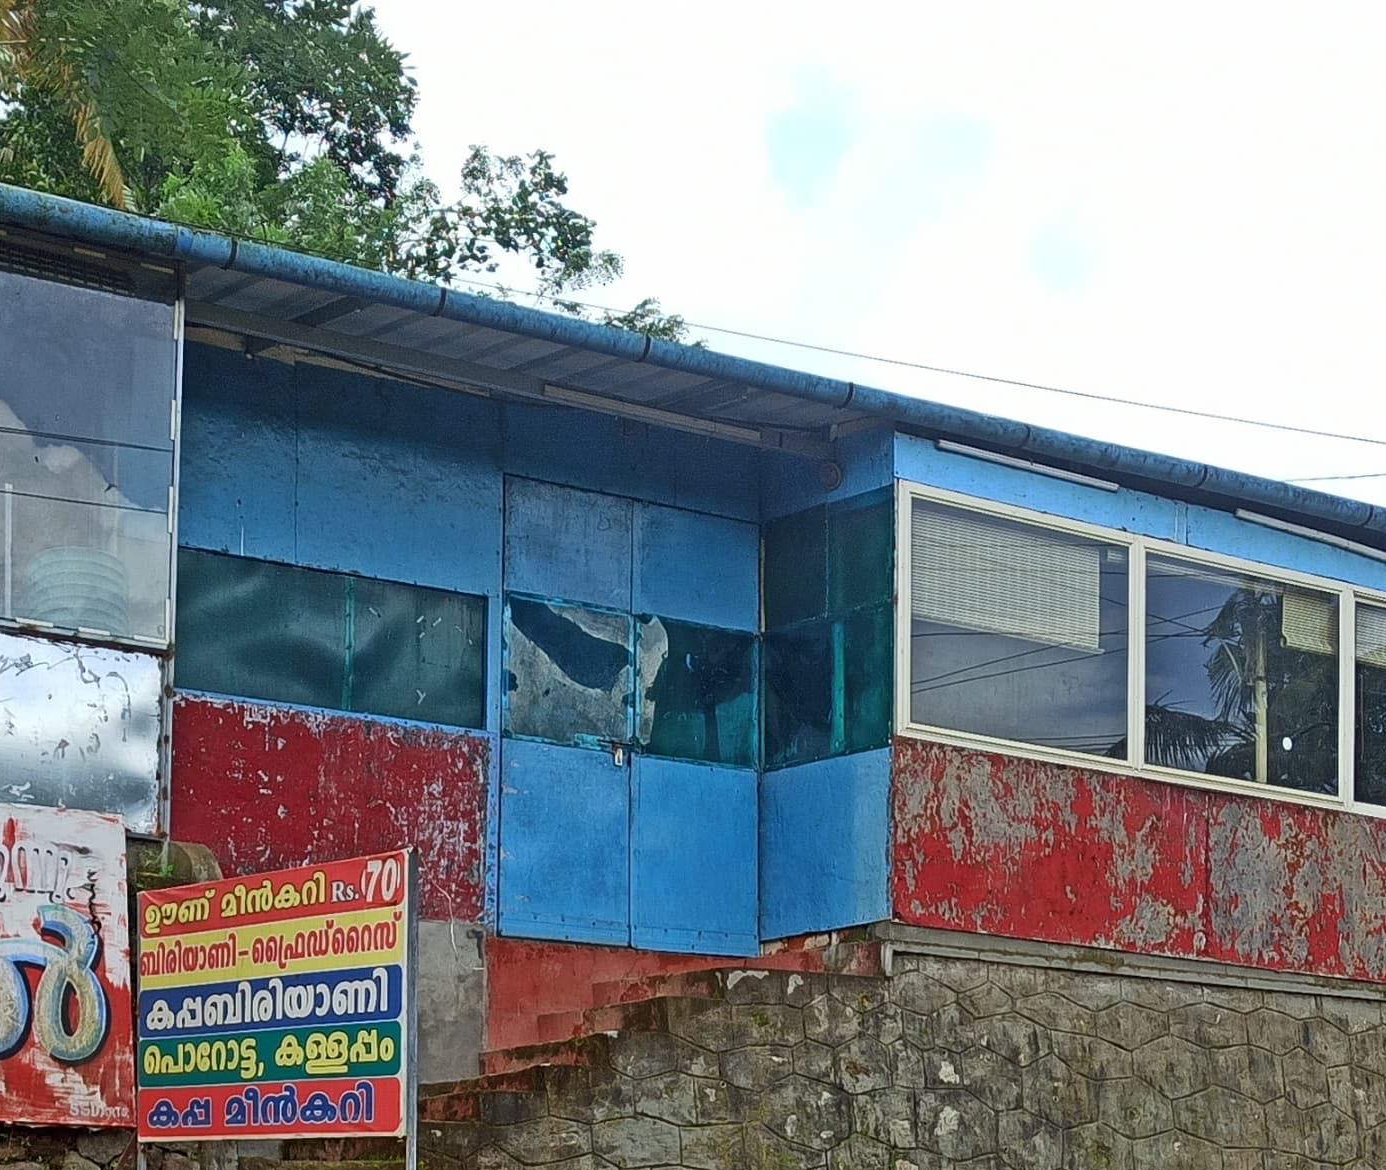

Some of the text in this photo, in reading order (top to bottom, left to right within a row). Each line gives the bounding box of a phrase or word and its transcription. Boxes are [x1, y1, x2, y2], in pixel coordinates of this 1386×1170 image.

[144, 887, 216, 934] ഊണ്
[220, 871, 326, 918] മീൻകറി
[330, 880, 360, 904] Rs.
[145, 966, 390, 1031] കപ്പബിരിയാണി
[274, 1028, 395, 1075] കള്ളപ്പം
[147, 1097, 212, 1128] കപ്പ
[224, 1079, 375, 1127] മീൻകറി
